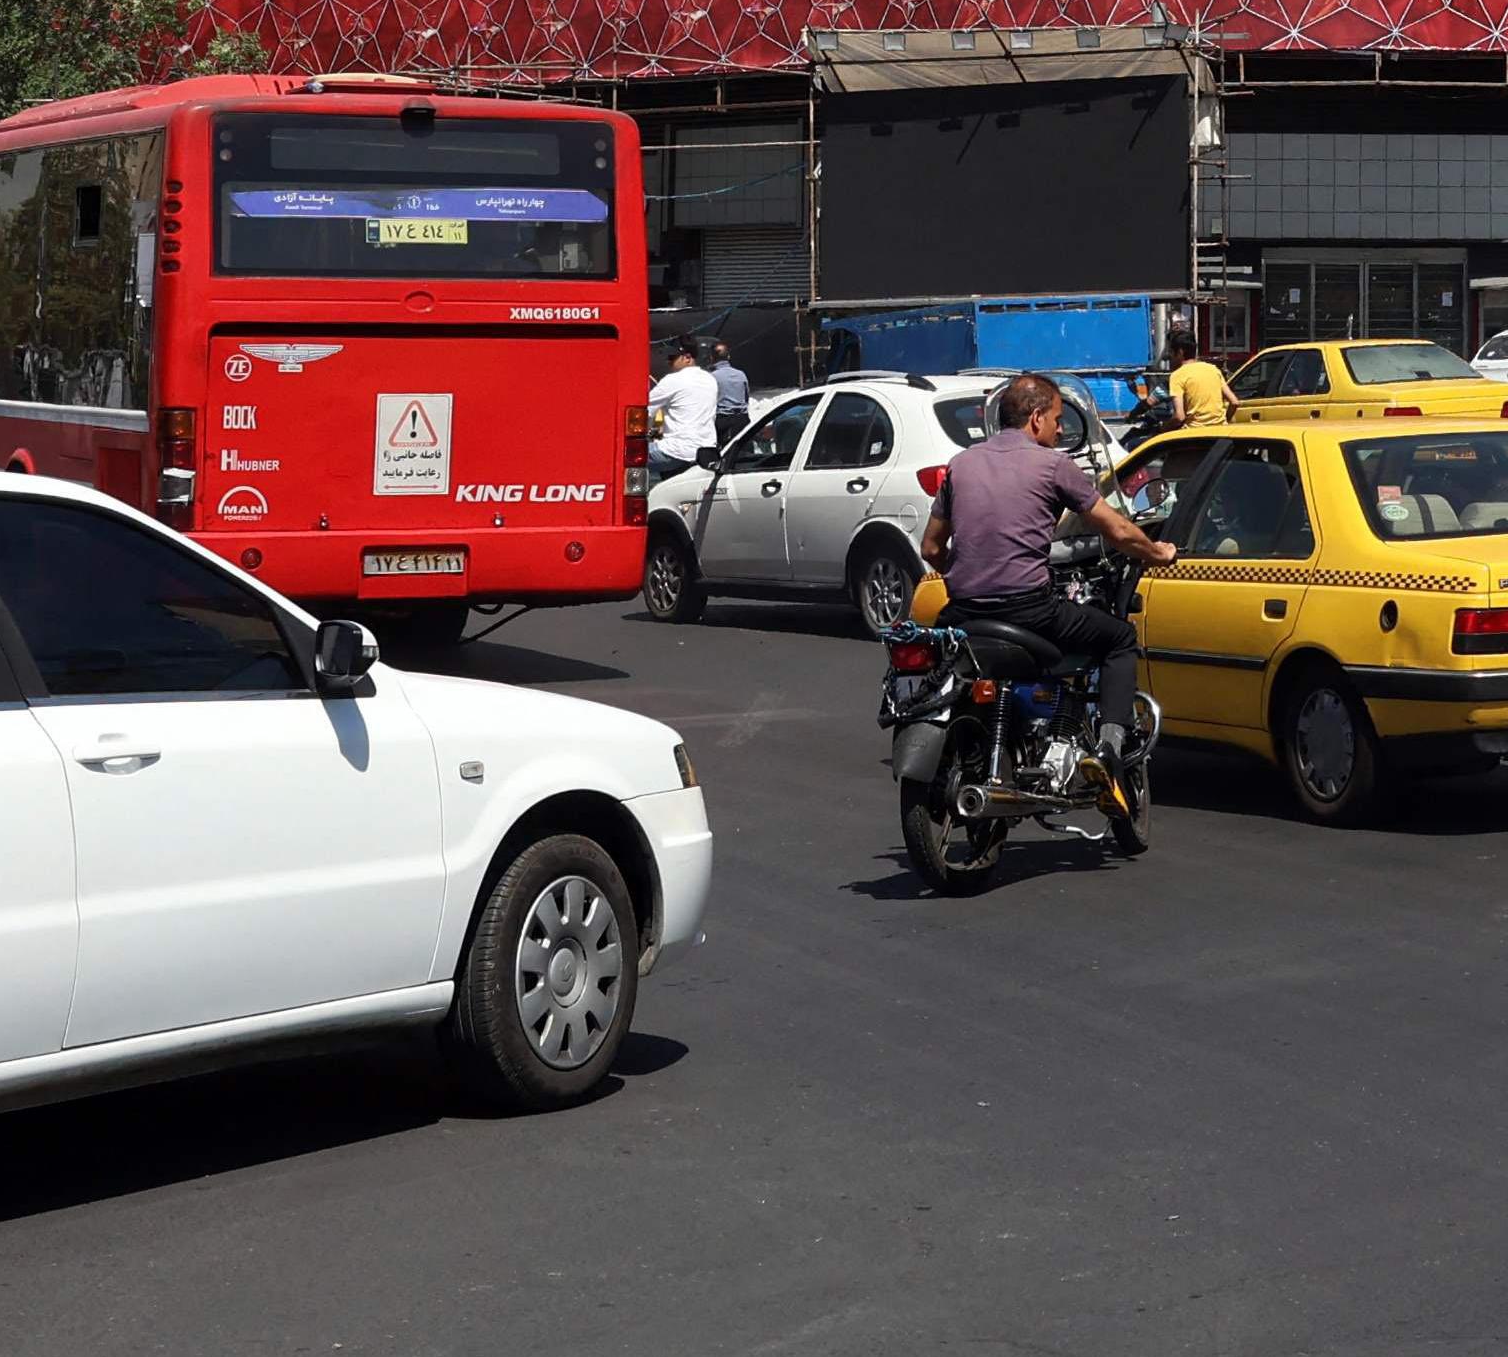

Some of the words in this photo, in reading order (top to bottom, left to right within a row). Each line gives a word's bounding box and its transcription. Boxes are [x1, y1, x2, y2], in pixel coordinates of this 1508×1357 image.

[509, 307, 600, 320] XMQ6180G1
[223, 405, 258, 430] BOCK
[416, 467, 441, 479] رعایت
[455, 484, 525, 502] KING
[529, 484, 606, 502] LONG
[223, 505, 263, 514] MAN
